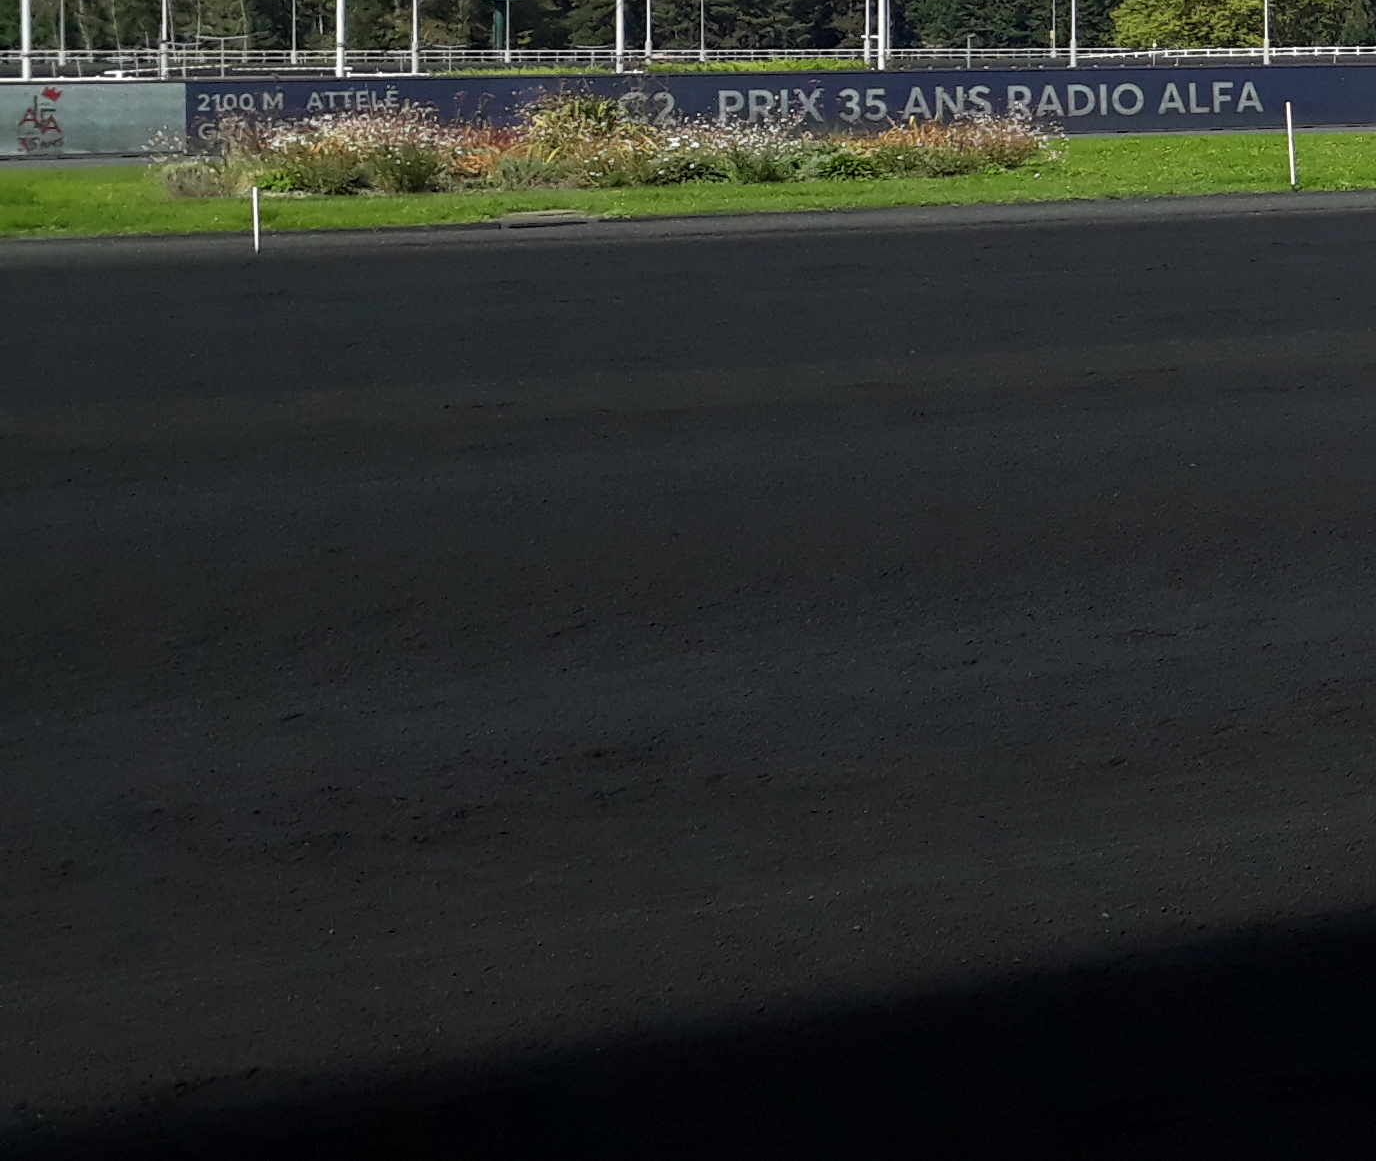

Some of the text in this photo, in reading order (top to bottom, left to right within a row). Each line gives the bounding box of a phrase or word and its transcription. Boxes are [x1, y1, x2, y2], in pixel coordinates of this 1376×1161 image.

[197, 93, 254, 111] 2100
[263, 92, 284, 110] M
[717, 89, 825, 123] PRIX
[838, 88, 887, 122] 35
[902, 86, 993, 122] ANS
[1006, 82, 1145, 116] RADIO
[1158, 81, 1265, 115] ALFA
